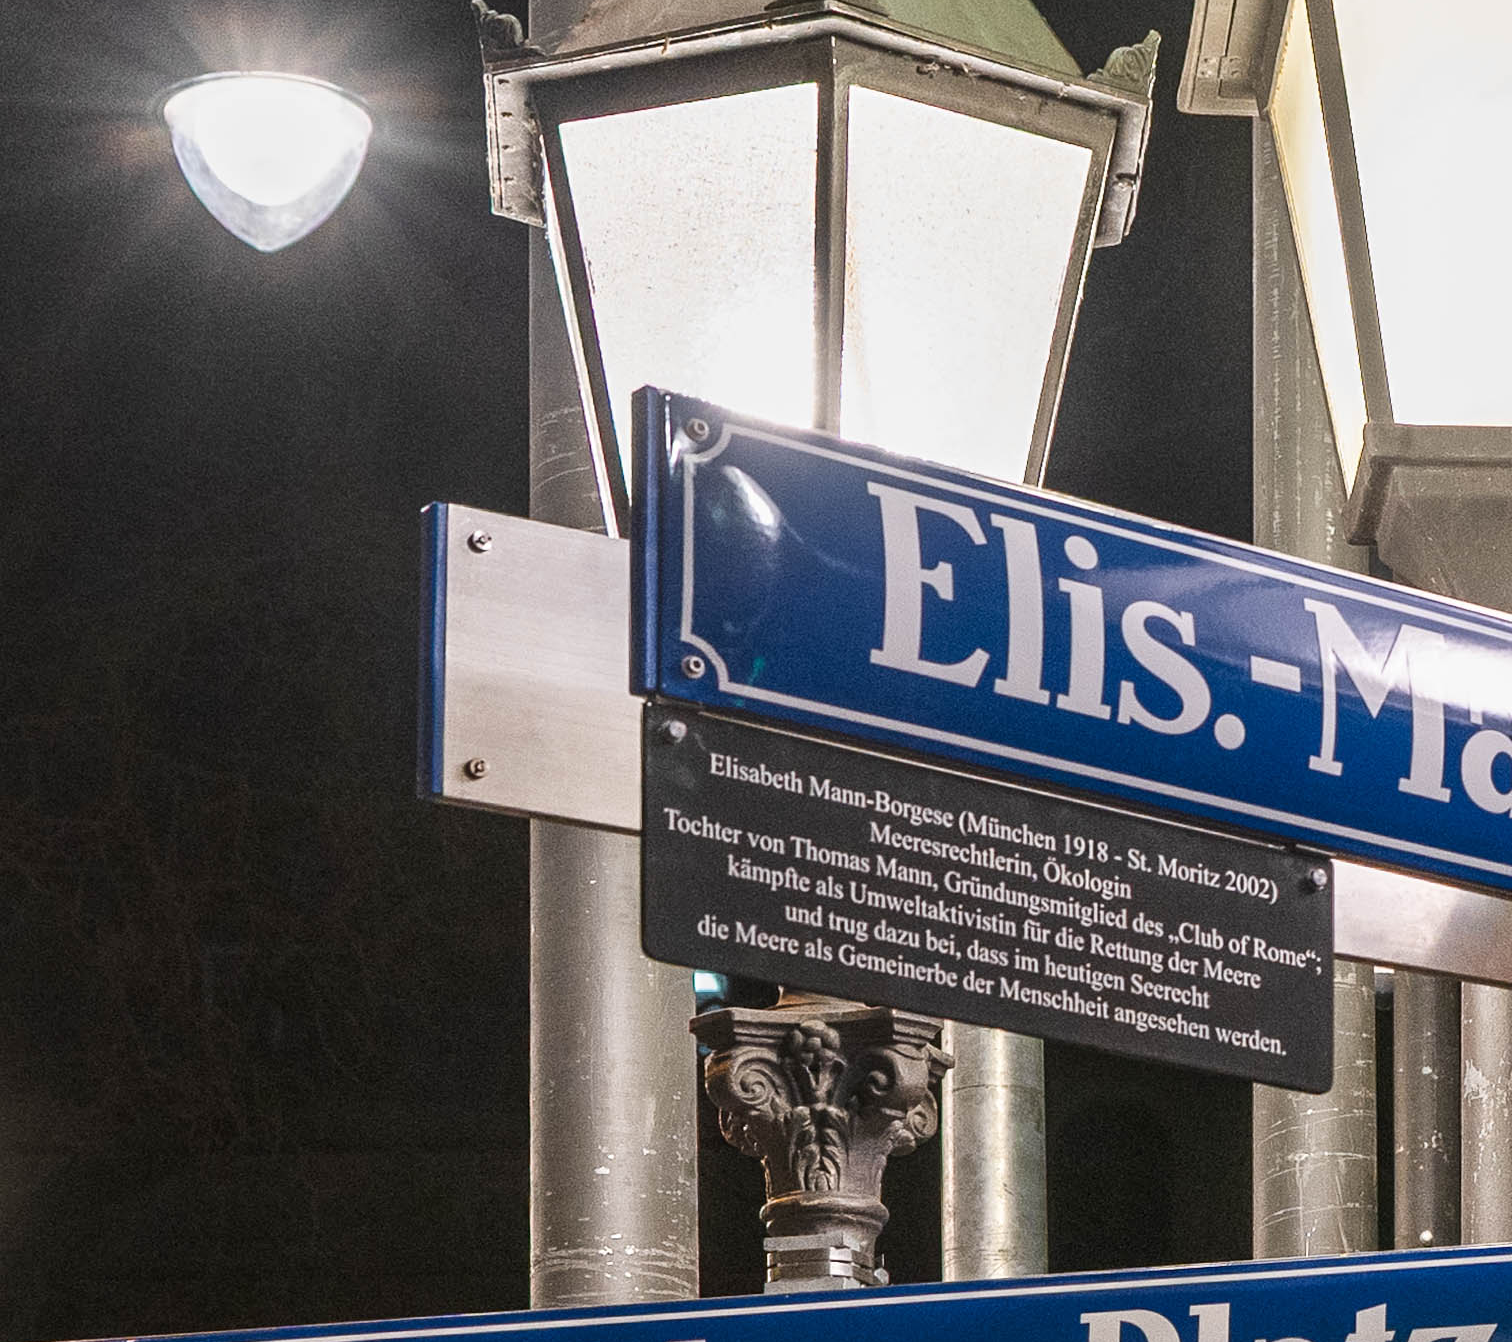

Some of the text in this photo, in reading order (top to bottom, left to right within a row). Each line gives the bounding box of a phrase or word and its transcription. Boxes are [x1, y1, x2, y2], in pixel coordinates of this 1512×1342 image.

[663, 807, 743, 844] Tochter
[747, 832, 785, 855] von
[790, 836, 870, 873] Thomas
[876, 854, 938, 892] Mann,
[944, 871, 1128, 930] Gründungsmitglied
[1132, 912, 1164, 937] des
[1228, 935, 1251, 956] of
[710, 752, 803, 794] Elisabeth
[809, 775, 954, 828] Mann-Borgese
[958, 811, 1056, 851] (München
[1064, 834, 1108, 863] 1918
[1127, 848, 1152, 873] St.
[1158, 854, 1221, 888] Moritz
[1225, 870, 1278, 905] 2002)
[870, 821, 1132, 901] Meeresrechtlerin, Ökologin
[697, 914, 1287, 1056] die Meere als Gemeinerbe der Menschheit angesehen werden.
[728, 854, 1261, 989] kämpfte als Umweltaktivistin für die Rettung der Meere
[785, 905, 1210, 1009] und trug dazu bei, dass im heutigen Seerecht
